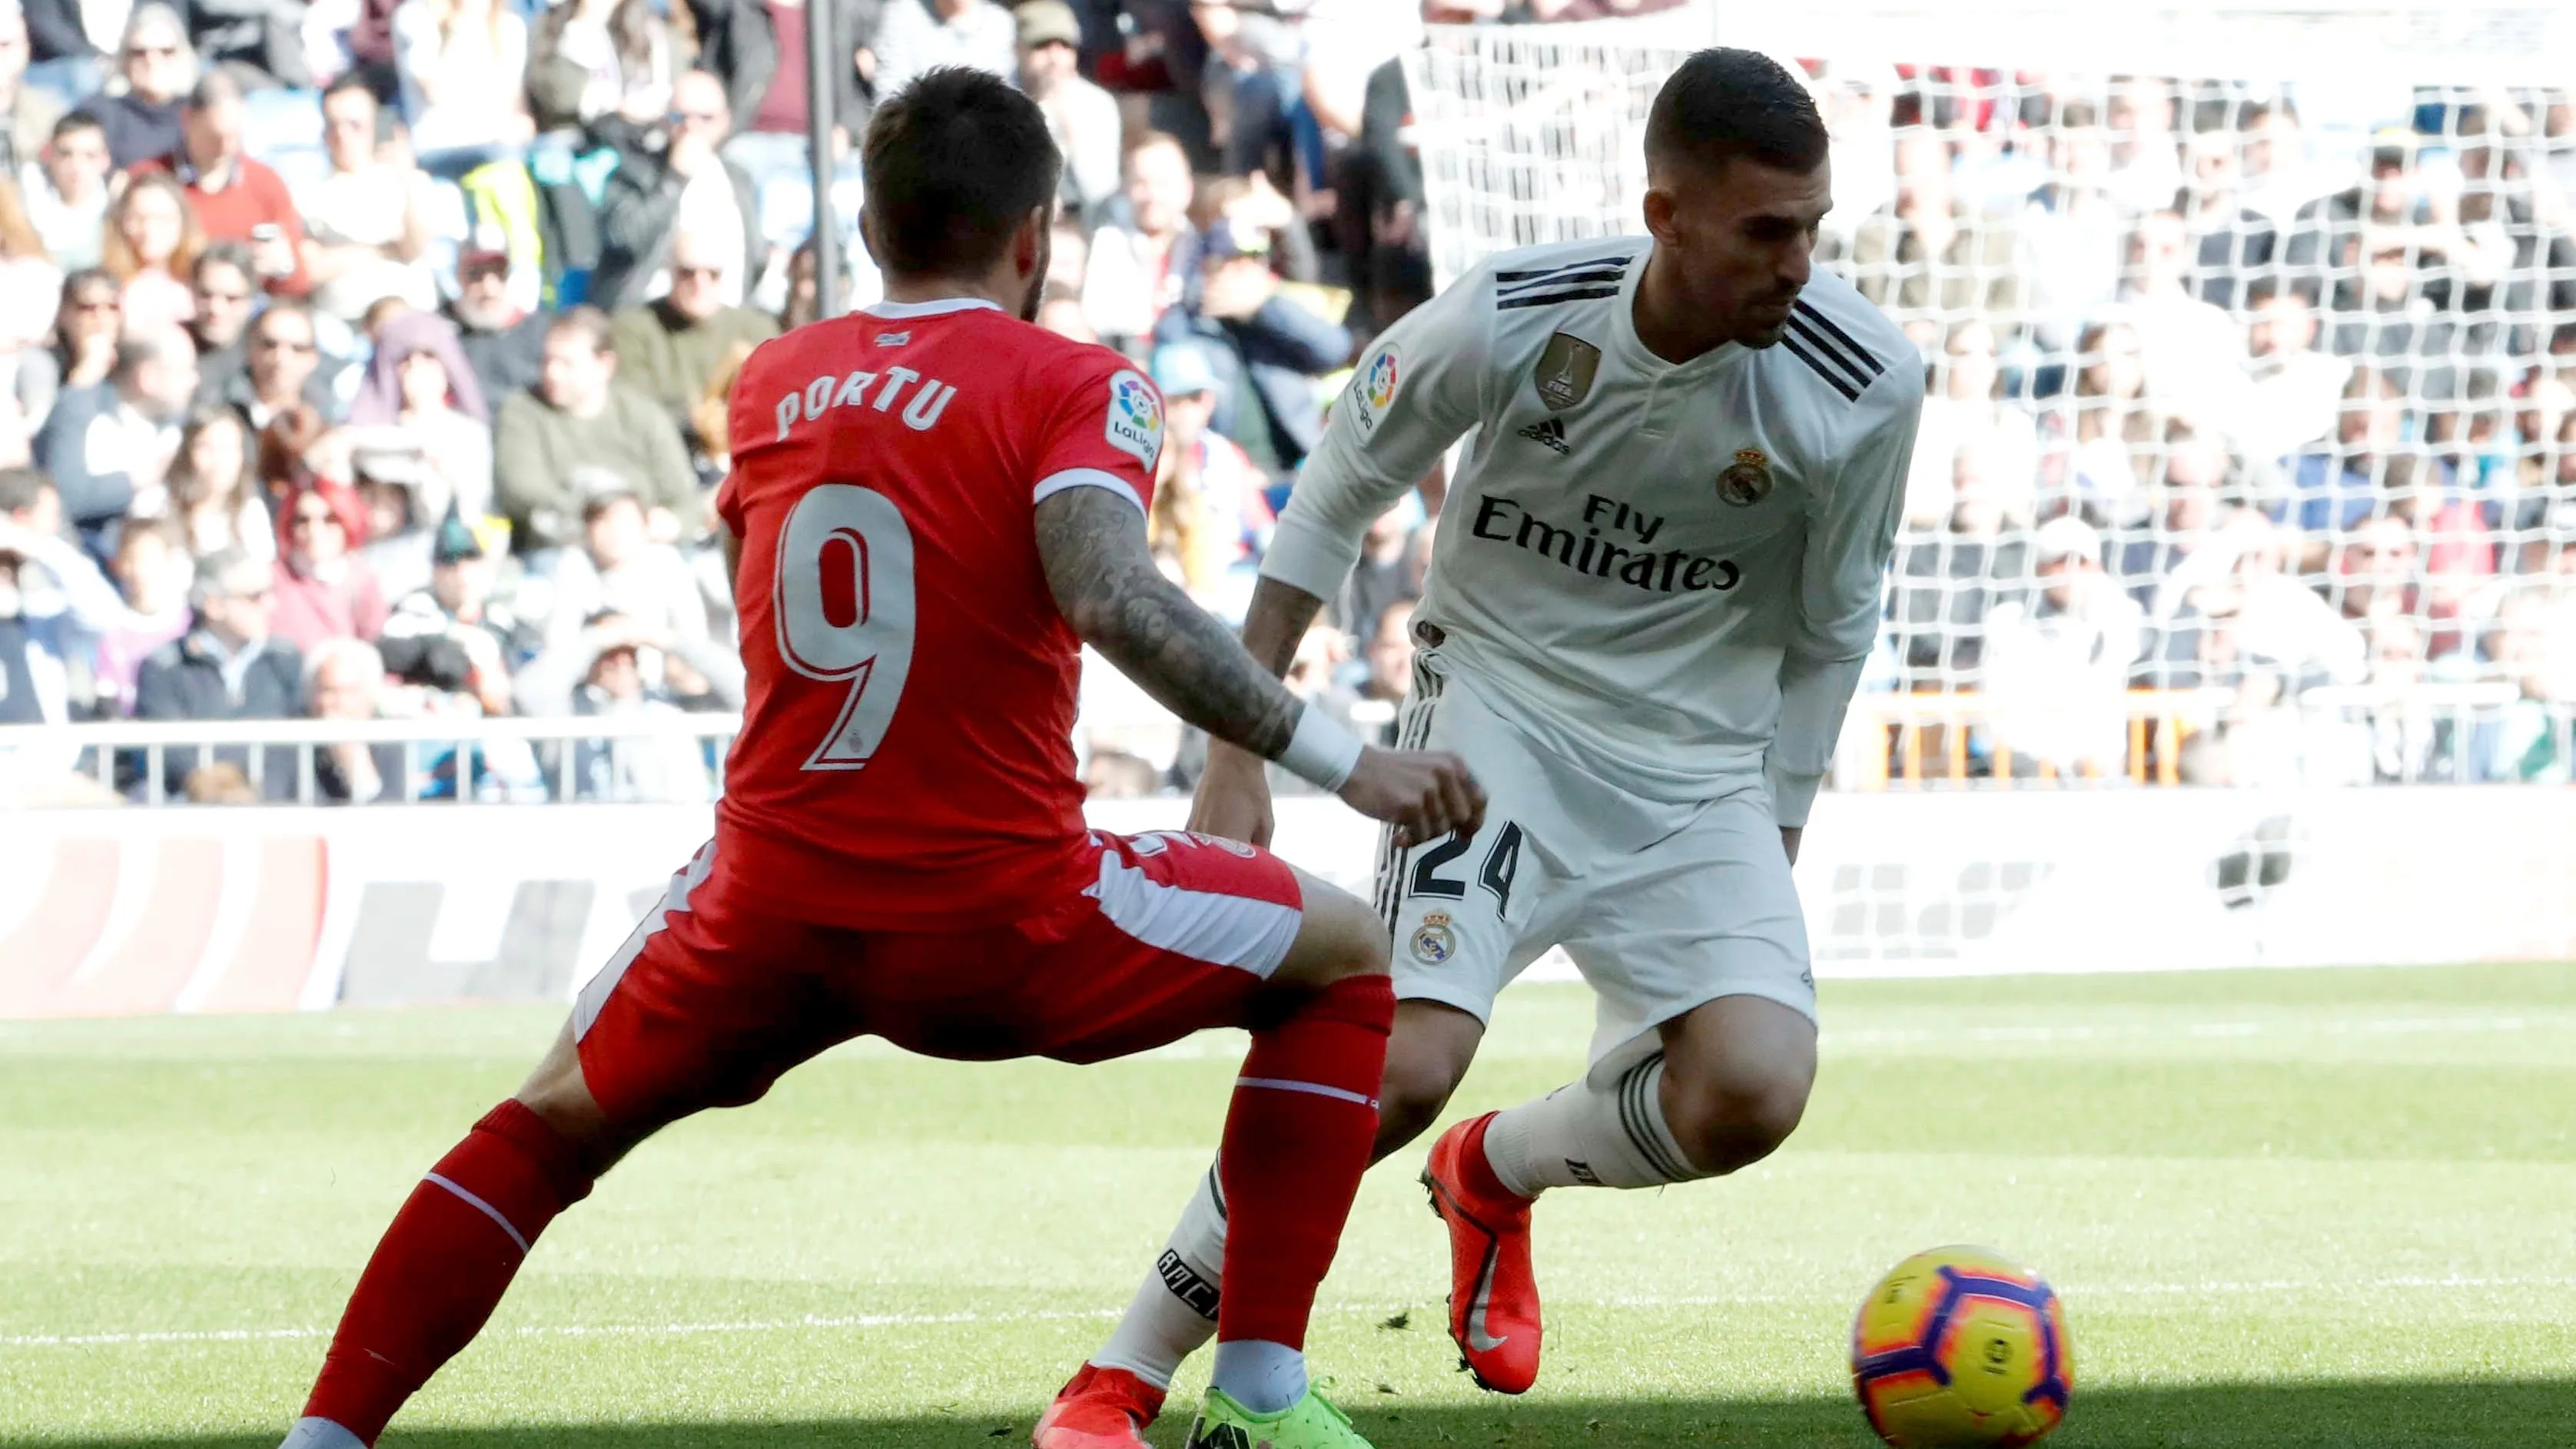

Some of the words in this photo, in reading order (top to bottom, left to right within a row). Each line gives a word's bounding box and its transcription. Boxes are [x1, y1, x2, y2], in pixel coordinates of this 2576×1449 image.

[775, 366, 958, 443] PORTU
[1114, 421, 1155, 459] LaLiga
[1517, 425, 1570, 456] adidas
[1472, 494, 1740, 592] Emirates
[1582, 493, 1665, 545] Fly
[773, 483, 916, 770] 9
[1408, 819, 1522, 923] 24
